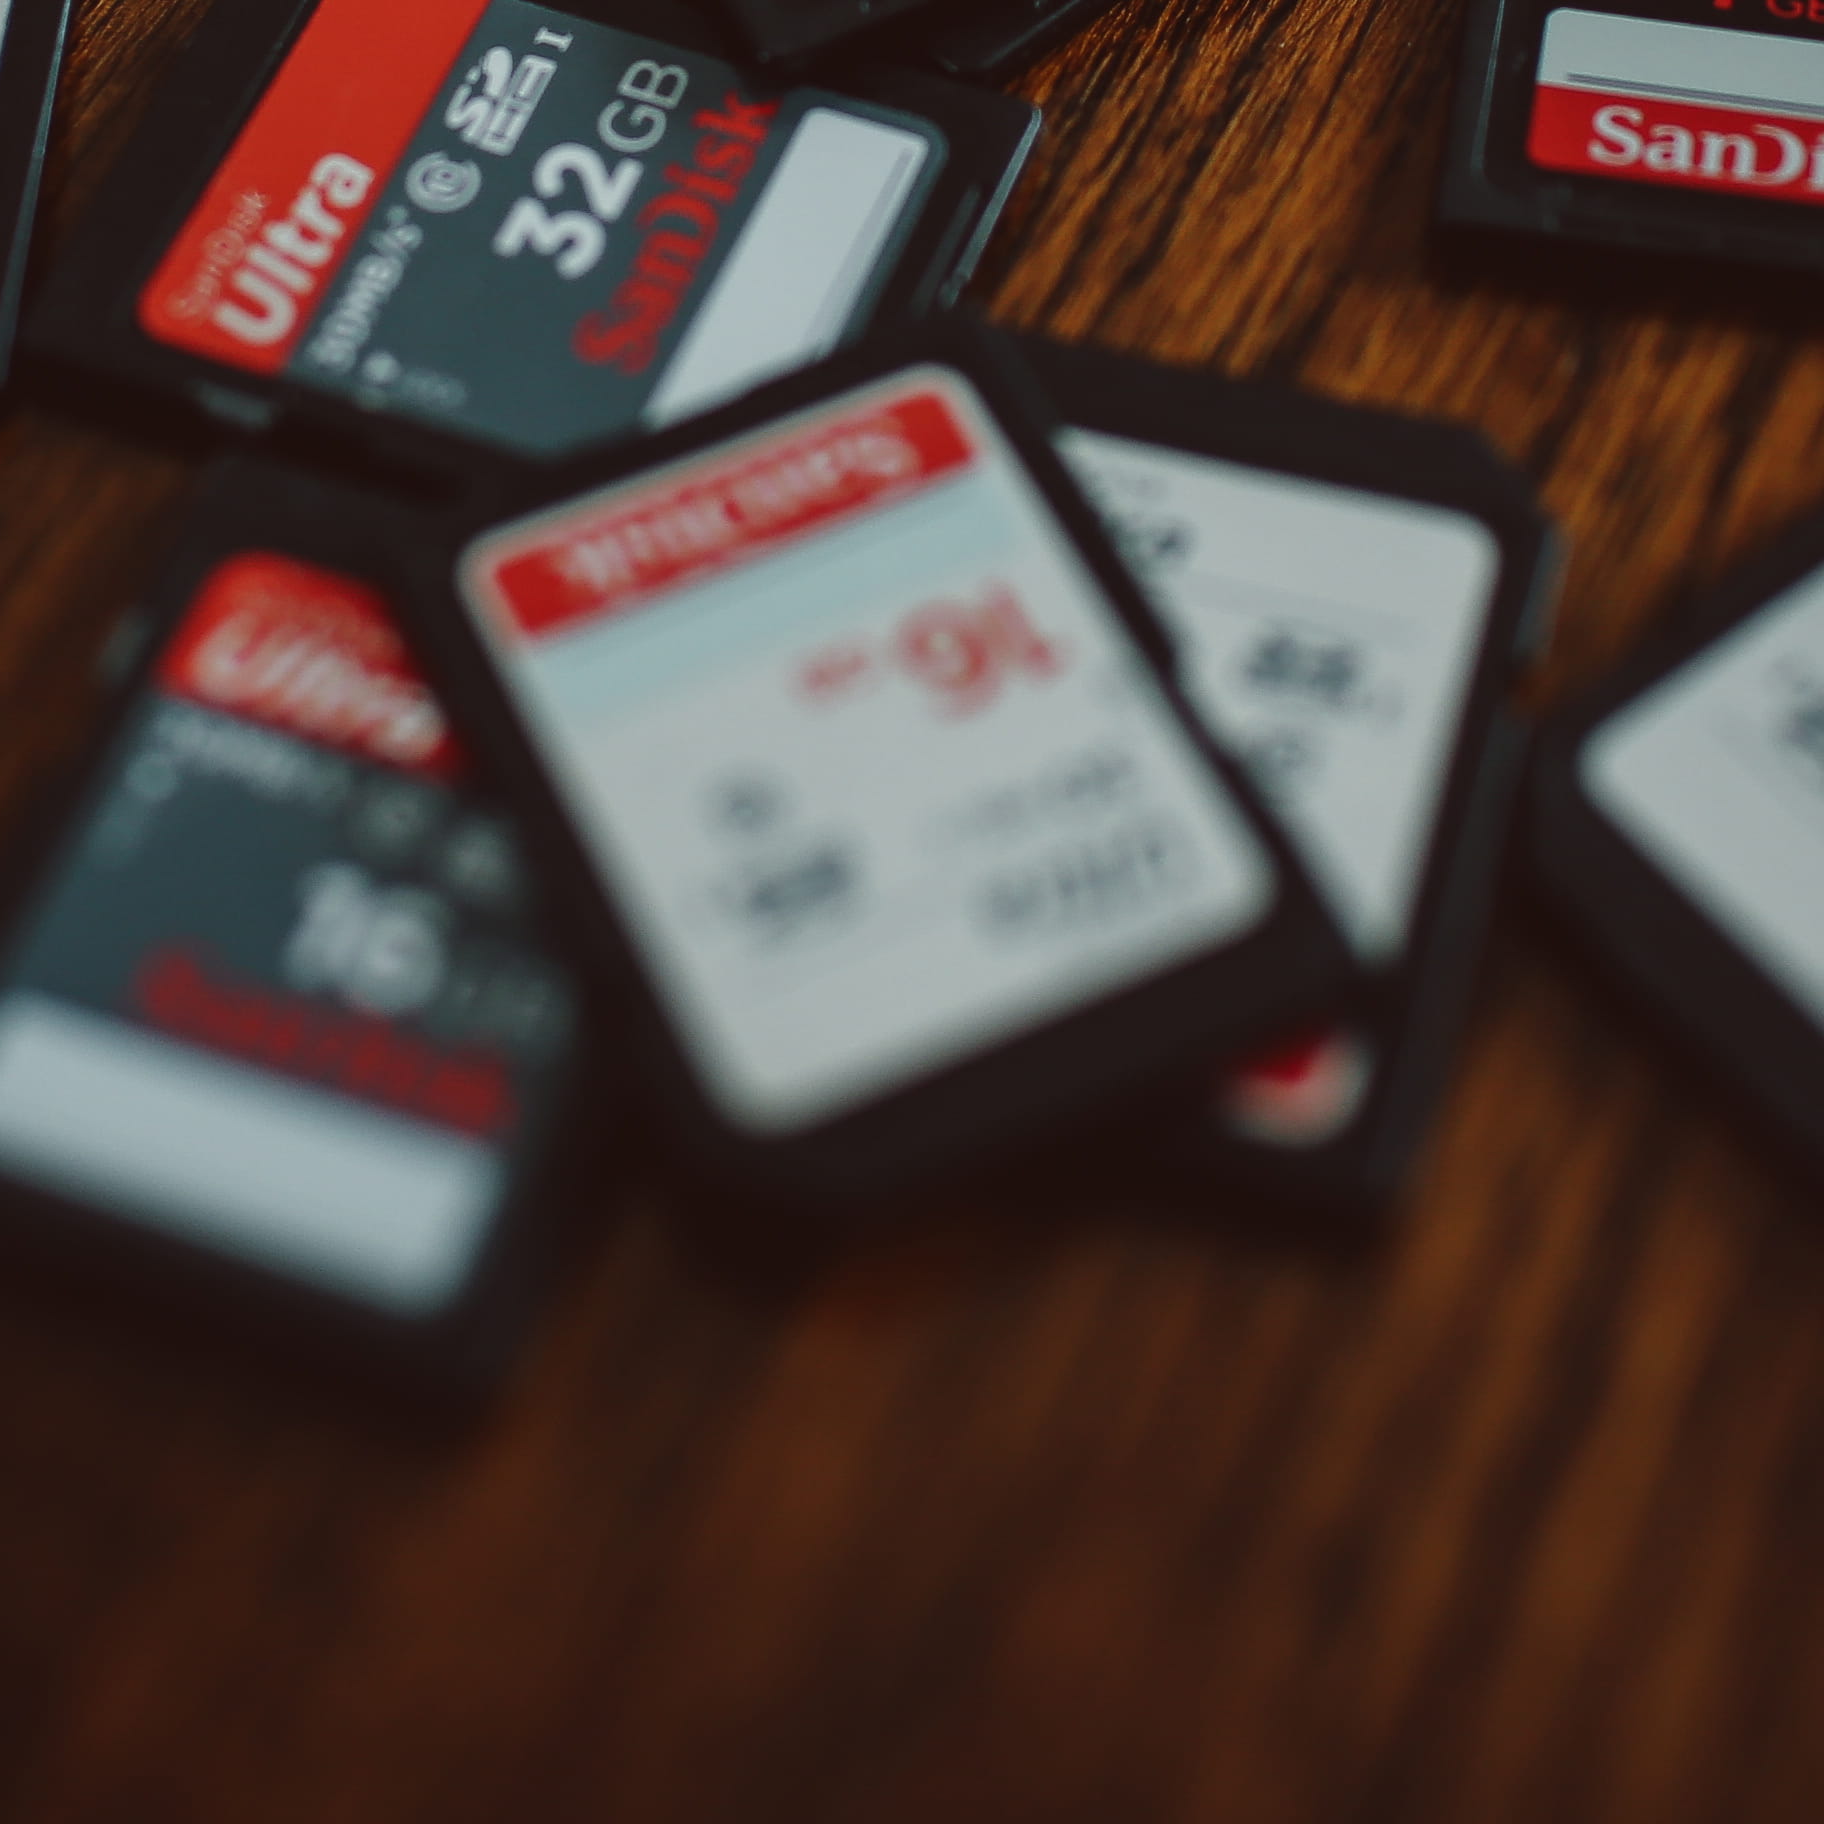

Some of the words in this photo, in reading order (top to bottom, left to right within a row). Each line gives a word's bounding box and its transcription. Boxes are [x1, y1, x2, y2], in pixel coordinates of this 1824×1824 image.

[213, 151, 376, 346] Ultra
[492, 139, 643, 280] 32
[596, 57, 689, 153] GB
[572, 89, 779, 376] SanDisk
[188, 610, 449, 769] Ultra
[891, 583, 1070, 721] 16
[284, 859, 449, 1021] 16
